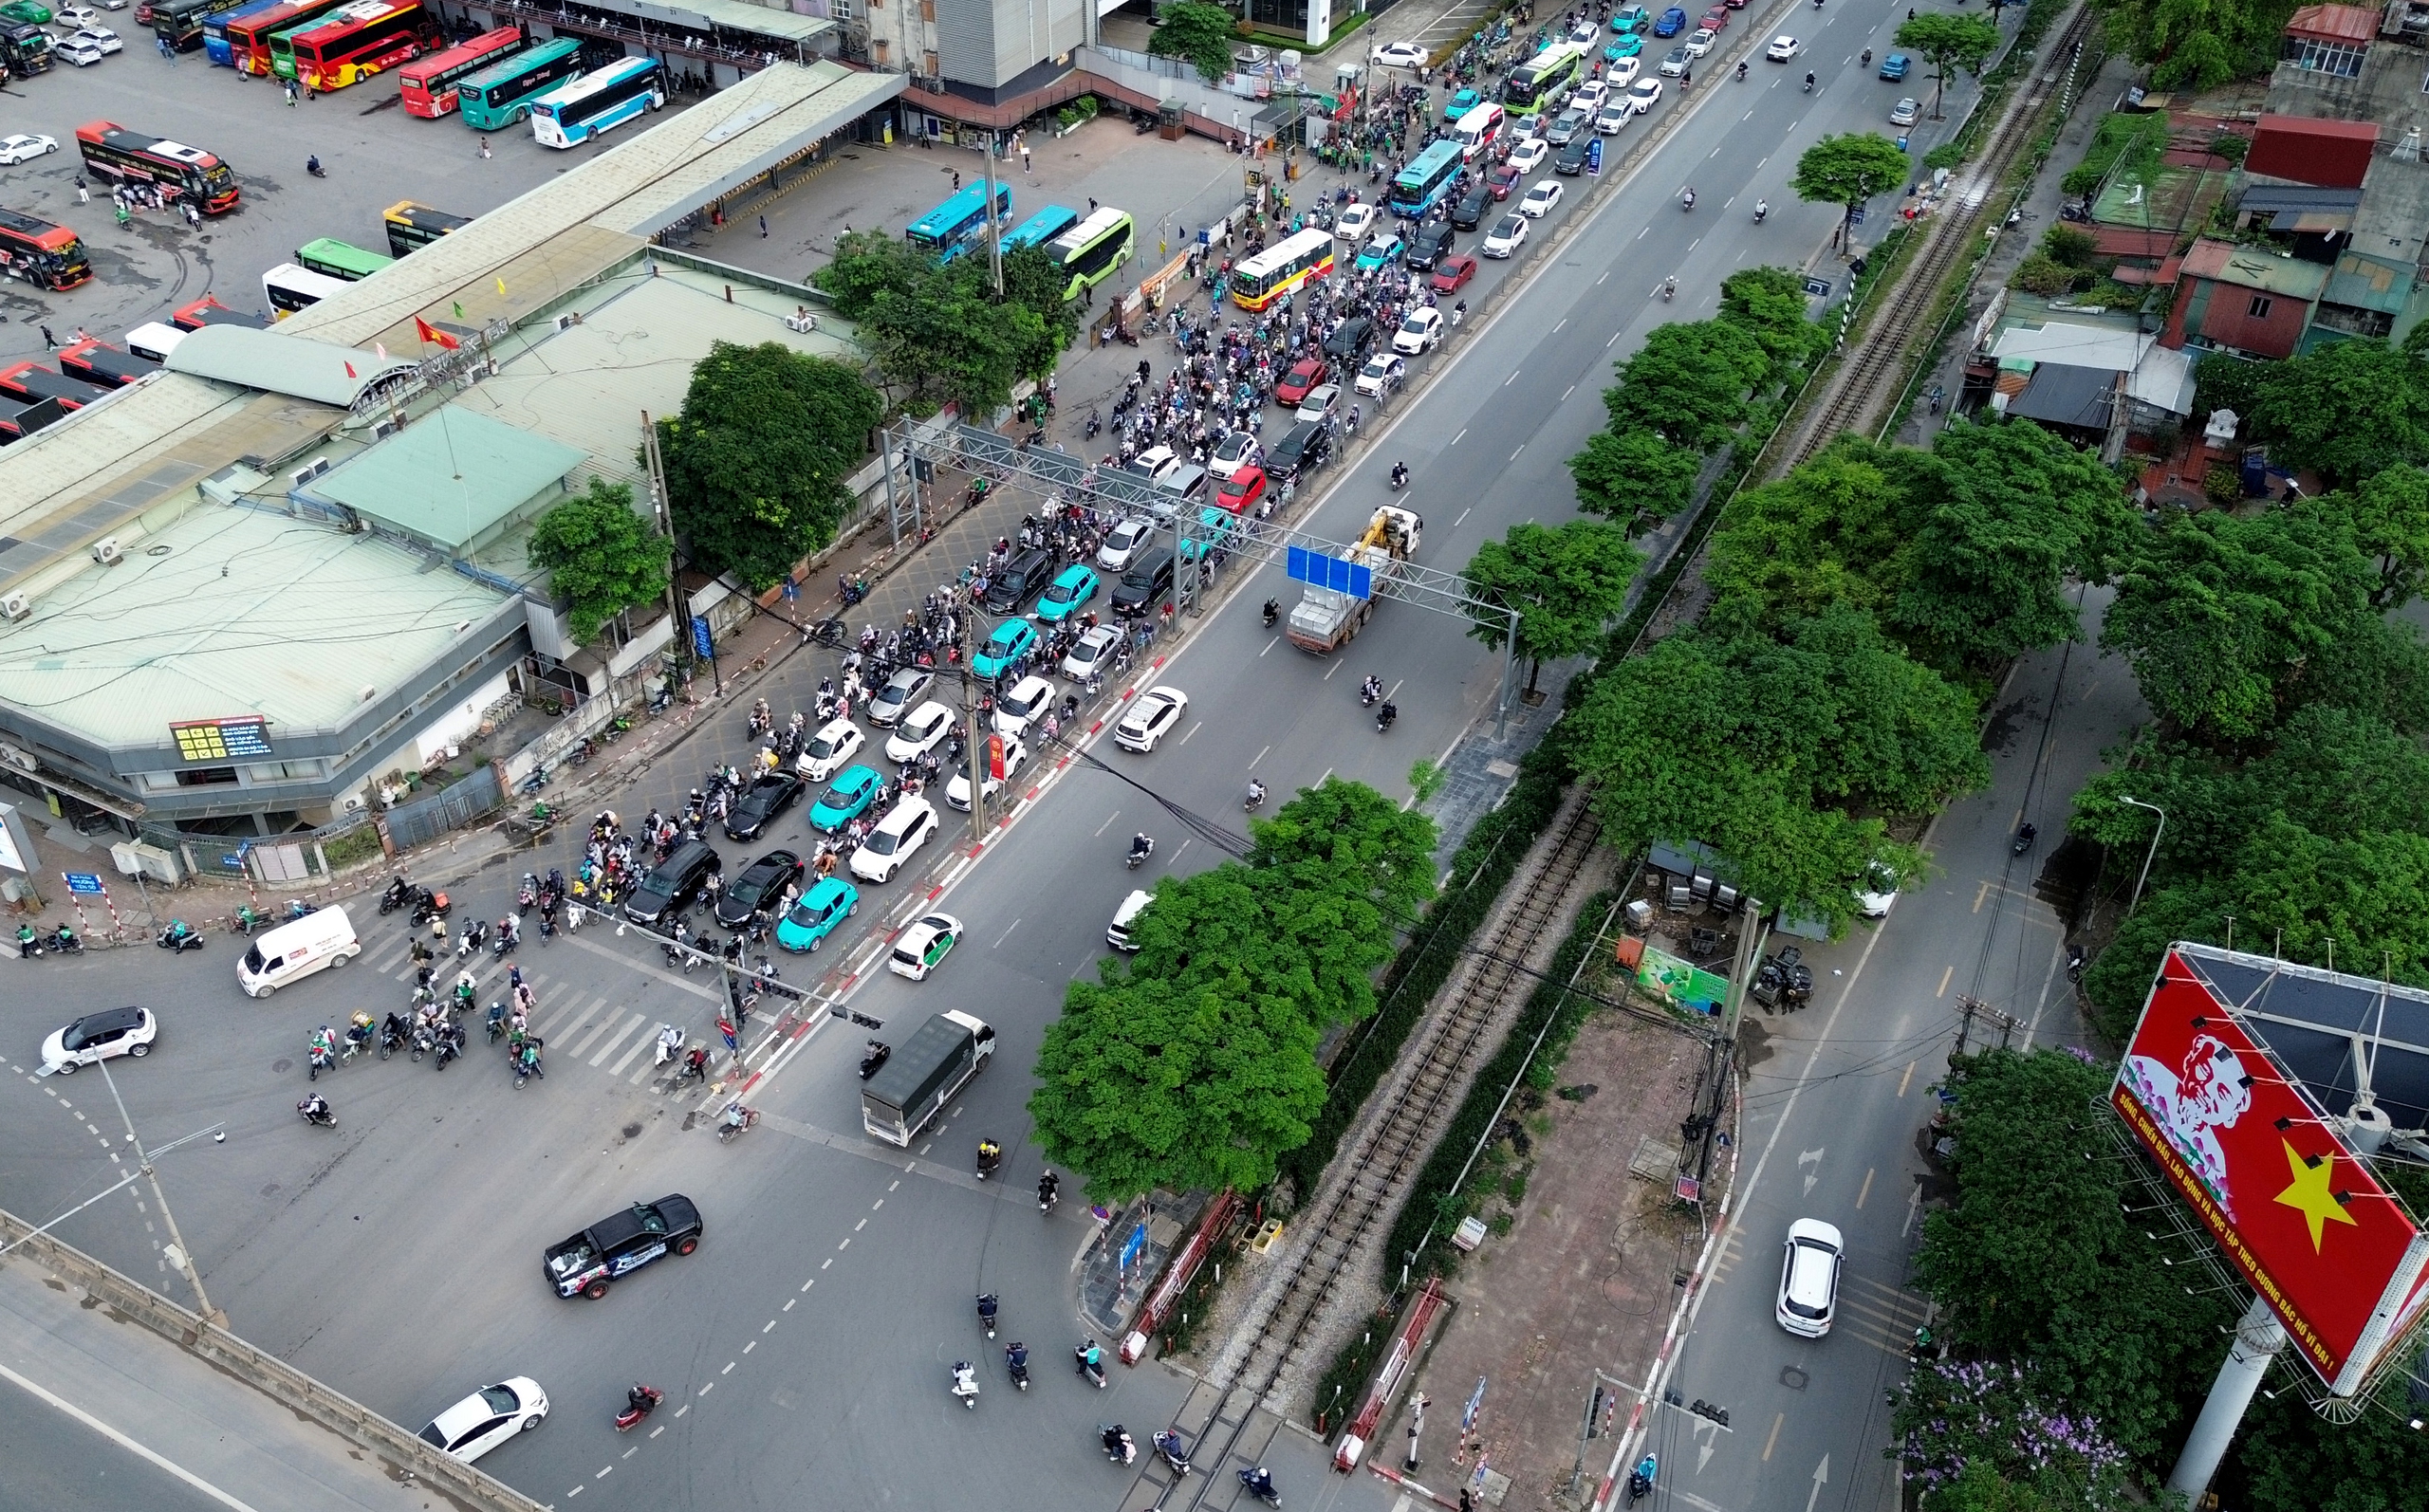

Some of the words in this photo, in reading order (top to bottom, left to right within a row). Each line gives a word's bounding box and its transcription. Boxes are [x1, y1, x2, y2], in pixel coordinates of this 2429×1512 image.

[1250, 172, 1258, 180] C1
[2119, 1094, 2138, 1122] SỐNG,
[2138, 1116, 2158, 1145] CHIẾN
[2155, 1143, 2170, 1165] ĐẤU,
[2170, 1158, 2184, 1180] LAO
[2182, 1175, 2202, 1203] ĐỘNG
[2201, 1197, 2212, 1215] VÀ
[2210, 1209, 2225, 1232] HỌC
[2224, 1227, 2239, 1247] TẬP
[2237, 1245, 2256, 1272] THEO
[2254, 1268, 2281, 1303] GƯƠNG
[2279, 1299, 2296, 1322] BÁC
[2294, 1318, 2308, 1337] HỒ
[2306, 1332, 2317, 1348] VĨ
[2313, 1342, 2329, 1365] ĐẠI
